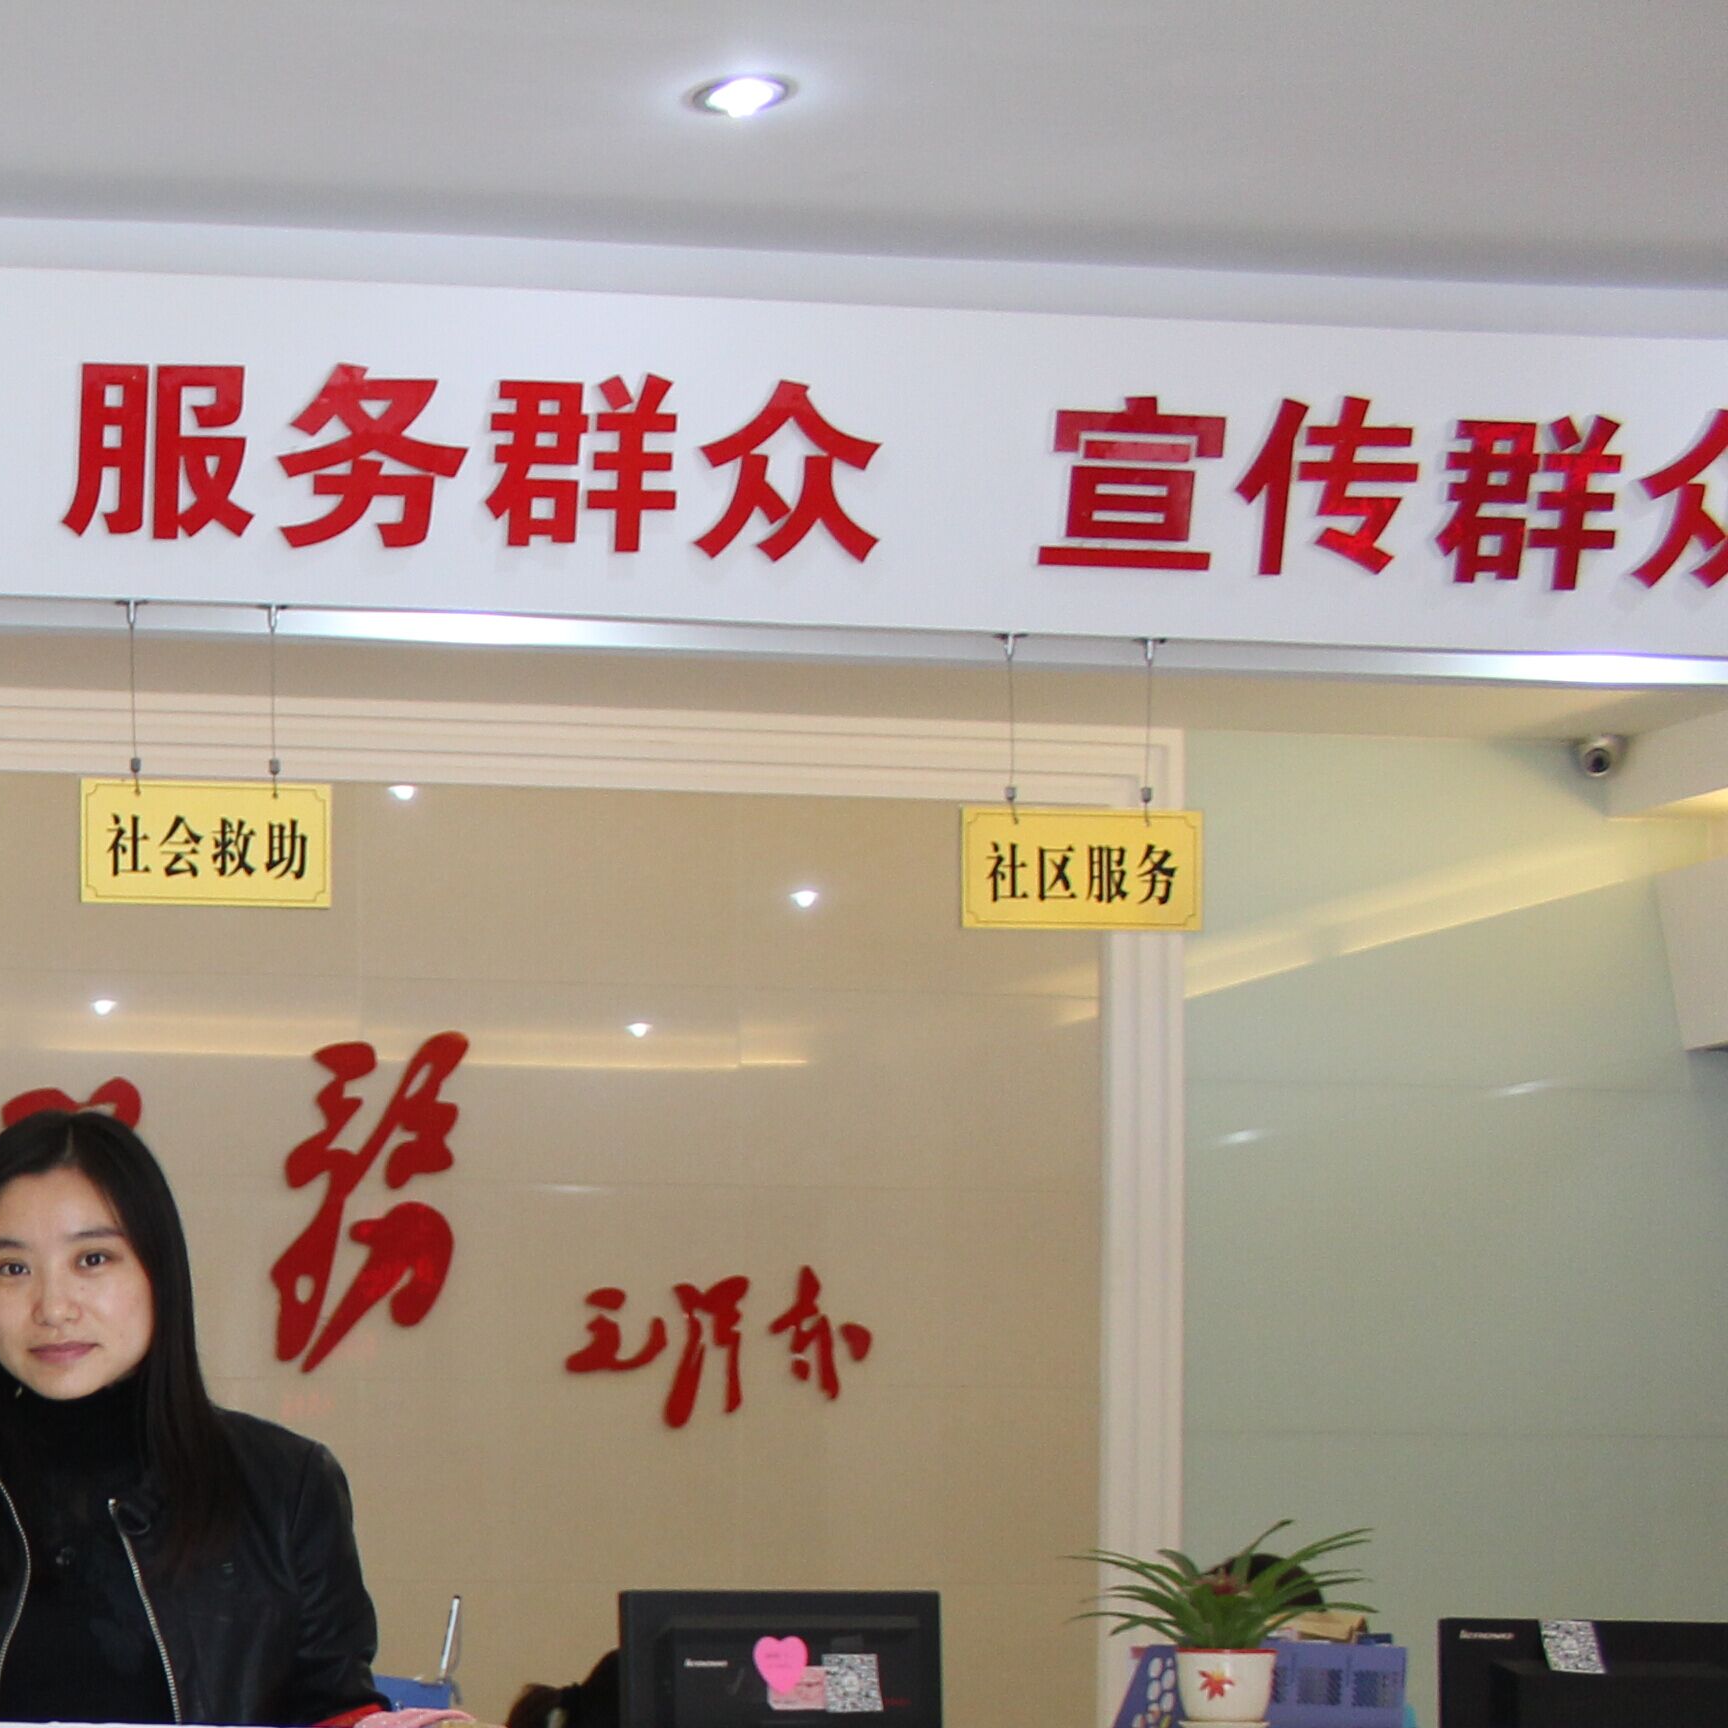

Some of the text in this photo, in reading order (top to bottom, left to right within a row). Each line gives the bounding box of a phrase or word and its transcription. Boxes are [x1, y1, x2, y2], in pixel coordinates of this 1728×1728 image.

[61, 361, 882, 563] 服务群众
[106, 813, 307, 881] 社会救助
[985, 842, 1178, 906] 社区服务
